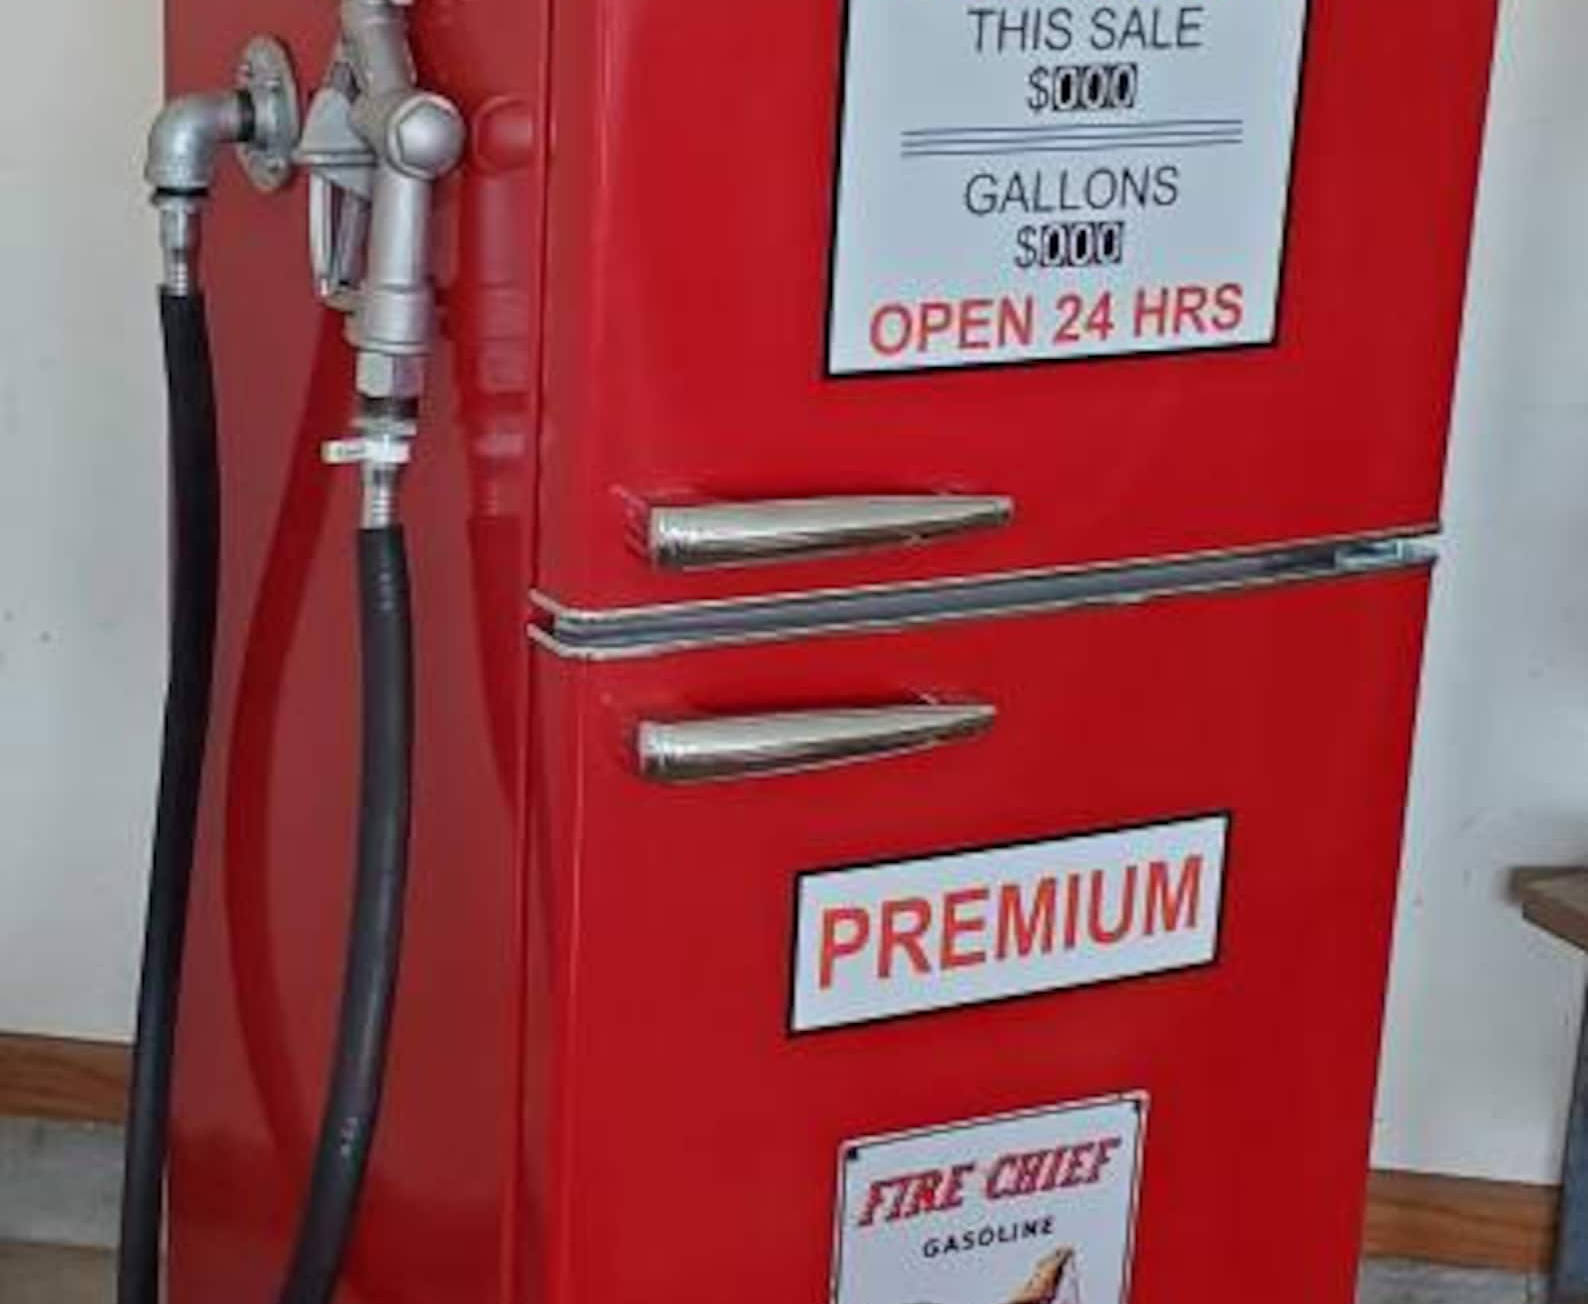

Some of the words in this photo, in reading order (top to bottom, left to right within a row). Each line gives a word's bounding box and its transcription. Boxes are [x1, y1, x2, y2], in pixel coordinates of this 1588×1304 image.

[968, 7, 1073, 52] THIS
[1090, 5, 1204, 50] SALE
[964, 166, 1180, 216] GALLONS
[869, 298, 1034, 355] OPEN
[1052, 292, 1115, 343] 24
[1133, 282, 1244, 337] HRS
[818, 854, 1203, 990] PREMIUM
[858, 1162, 975, 1227] FIRE
[985, 1137, 1122, 1200] CHIEF
[923, 1216, 1054, 1258] GASOLINE
